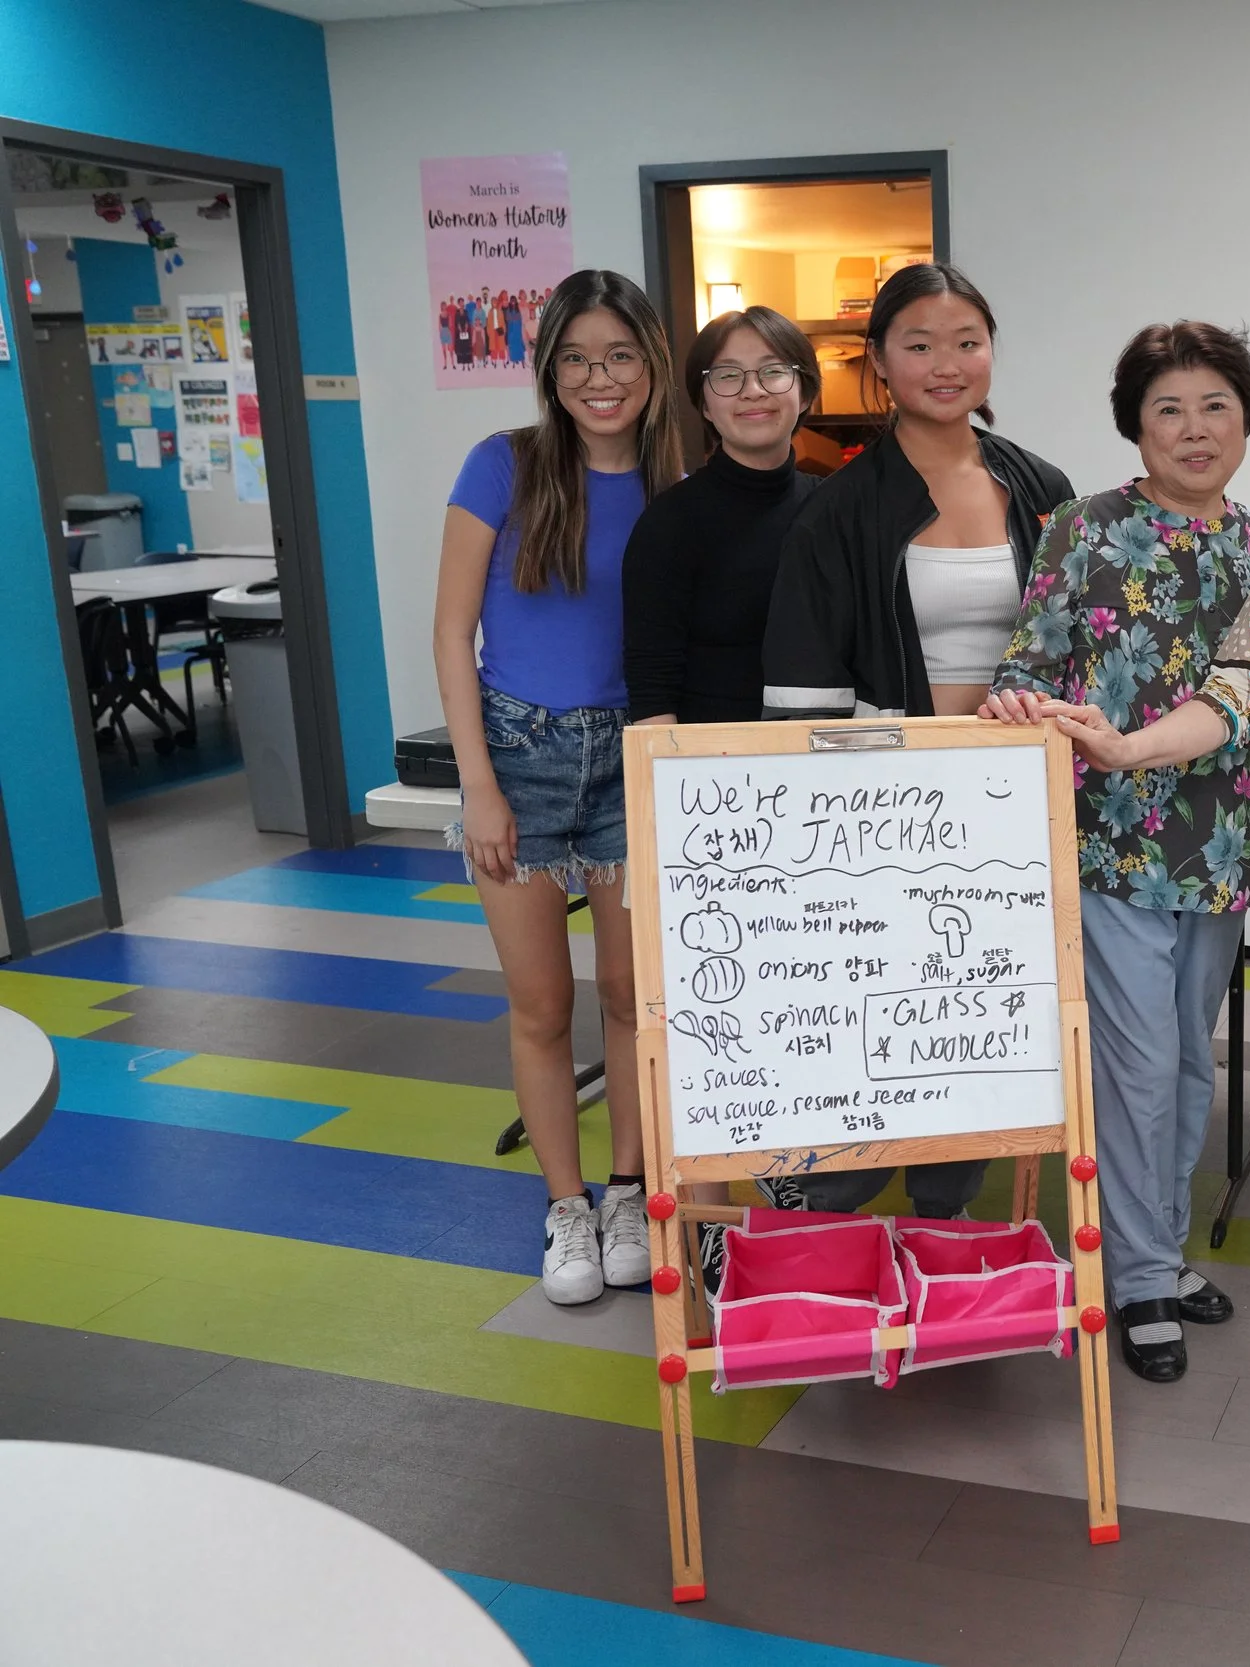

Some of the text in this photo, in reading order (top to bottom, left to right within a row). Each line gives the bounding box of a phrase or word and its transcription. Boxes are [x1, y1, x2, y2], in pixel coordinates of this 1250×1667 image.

[469, 183, 520, 197] March is
[428, 204, 568, 229] Women's History
[472, 236, 528, 259] Month
[680, 773, 945, 826] We're making
[747, 915, 889, 940] yellow bell pepper
[758, 955, 890, 982] onions 양파
[981, 947, 1013, 966] 설탕
[966, 961, 1026, 984] sugar
[784, 1032, 832, 1057] 시금치
[686, 1105, 720, 1126] soy
[792, 1090, 861, 1116] sesame
[867, 1088, 917, 1106] seed
[922, 1085, 952, 1102] oil
[729, 1111, 886, 1145] 간장 참기름
